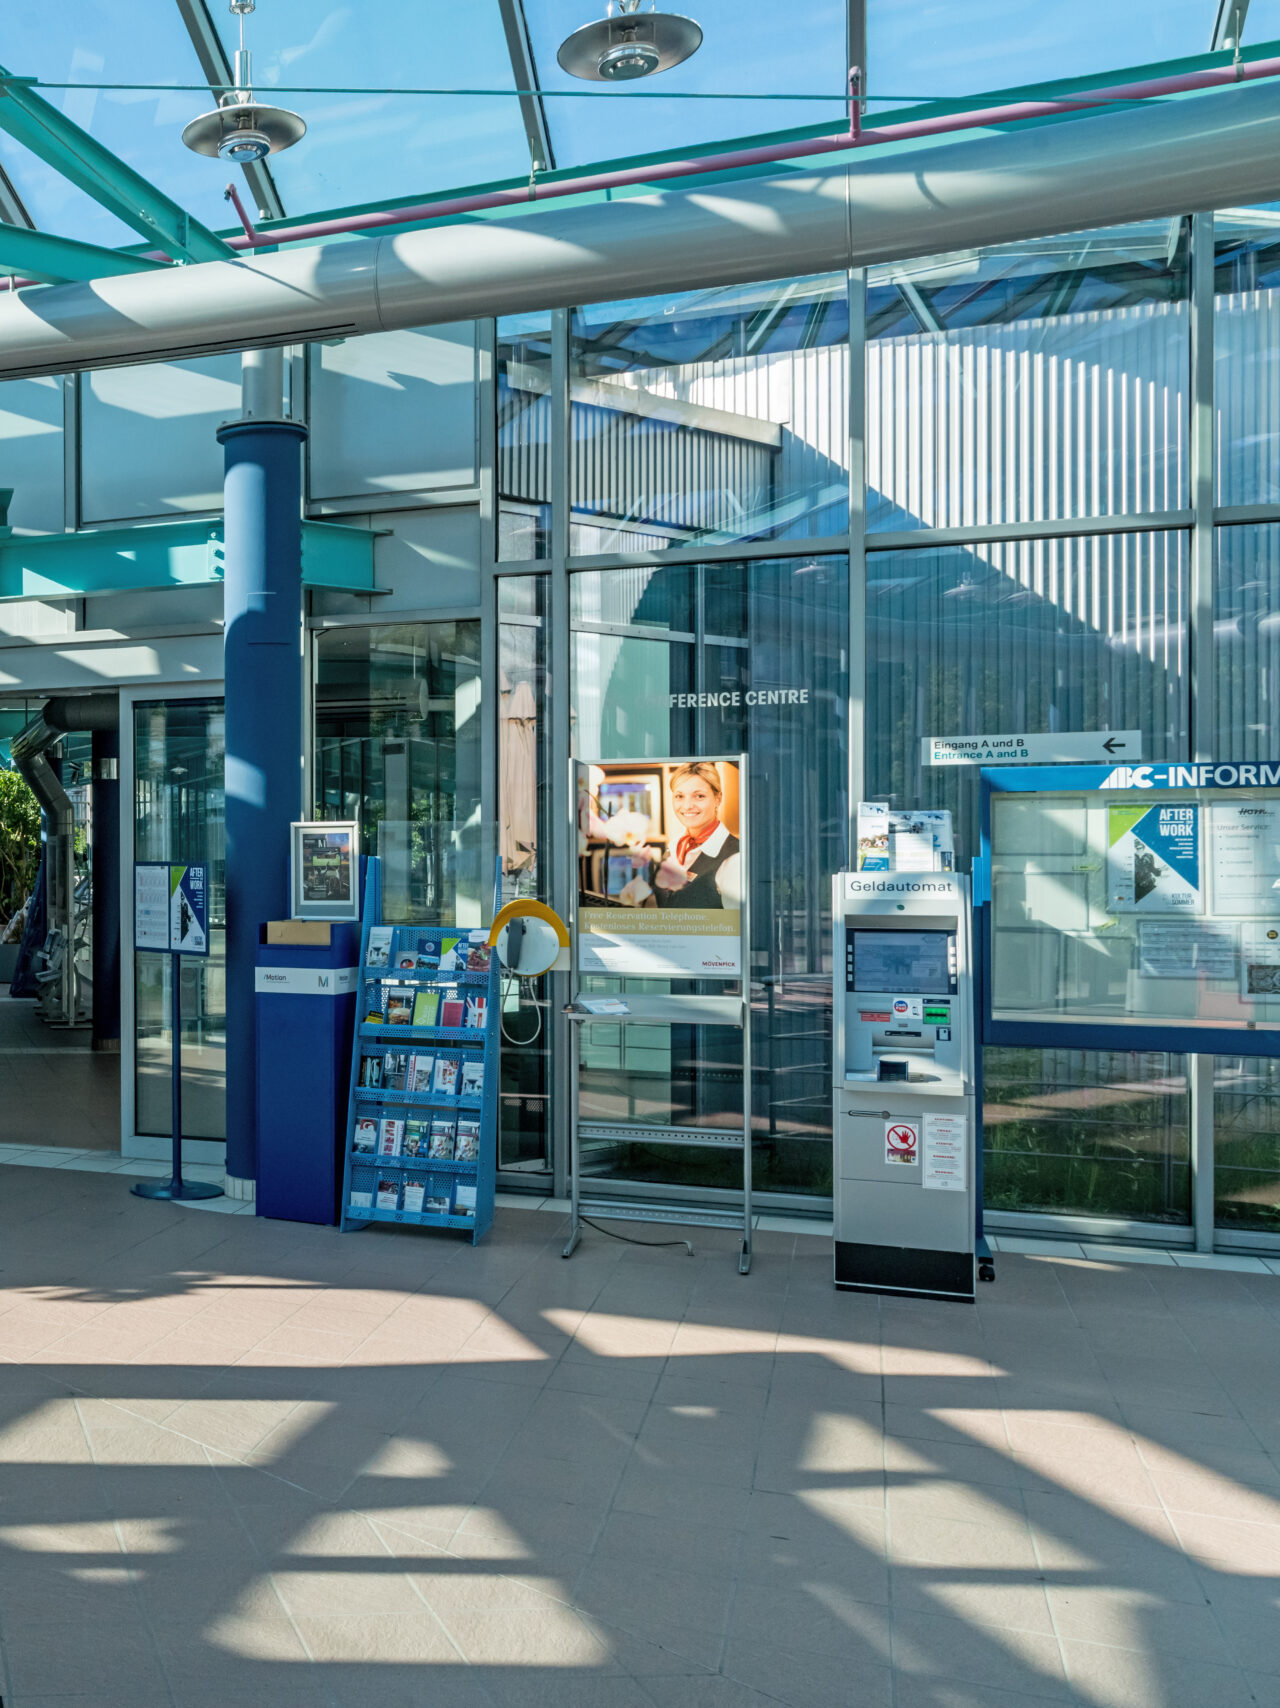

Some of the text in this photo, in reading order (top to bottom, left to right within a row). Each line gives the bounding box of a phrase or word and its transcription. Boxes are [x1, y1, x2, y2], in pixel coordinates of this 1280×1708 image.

[656, 689, 809, 709] FERENCE CENTRE
[934, 738, 1025, 751] Eingang A und B
[934, 749, 1029, 760] Entrance A and B
[1159, 808, 1193, 821] AFTER
[1159, 824, 1193, 836] WORK
[189, 867, 203, 877] AFTER
[850, 881, 952, 892] Geldautomat
[584, 911, 603, 920] Free
[606, 911, 657, 920] Reservation
[584, 922, 636, 931] Kostenloses
